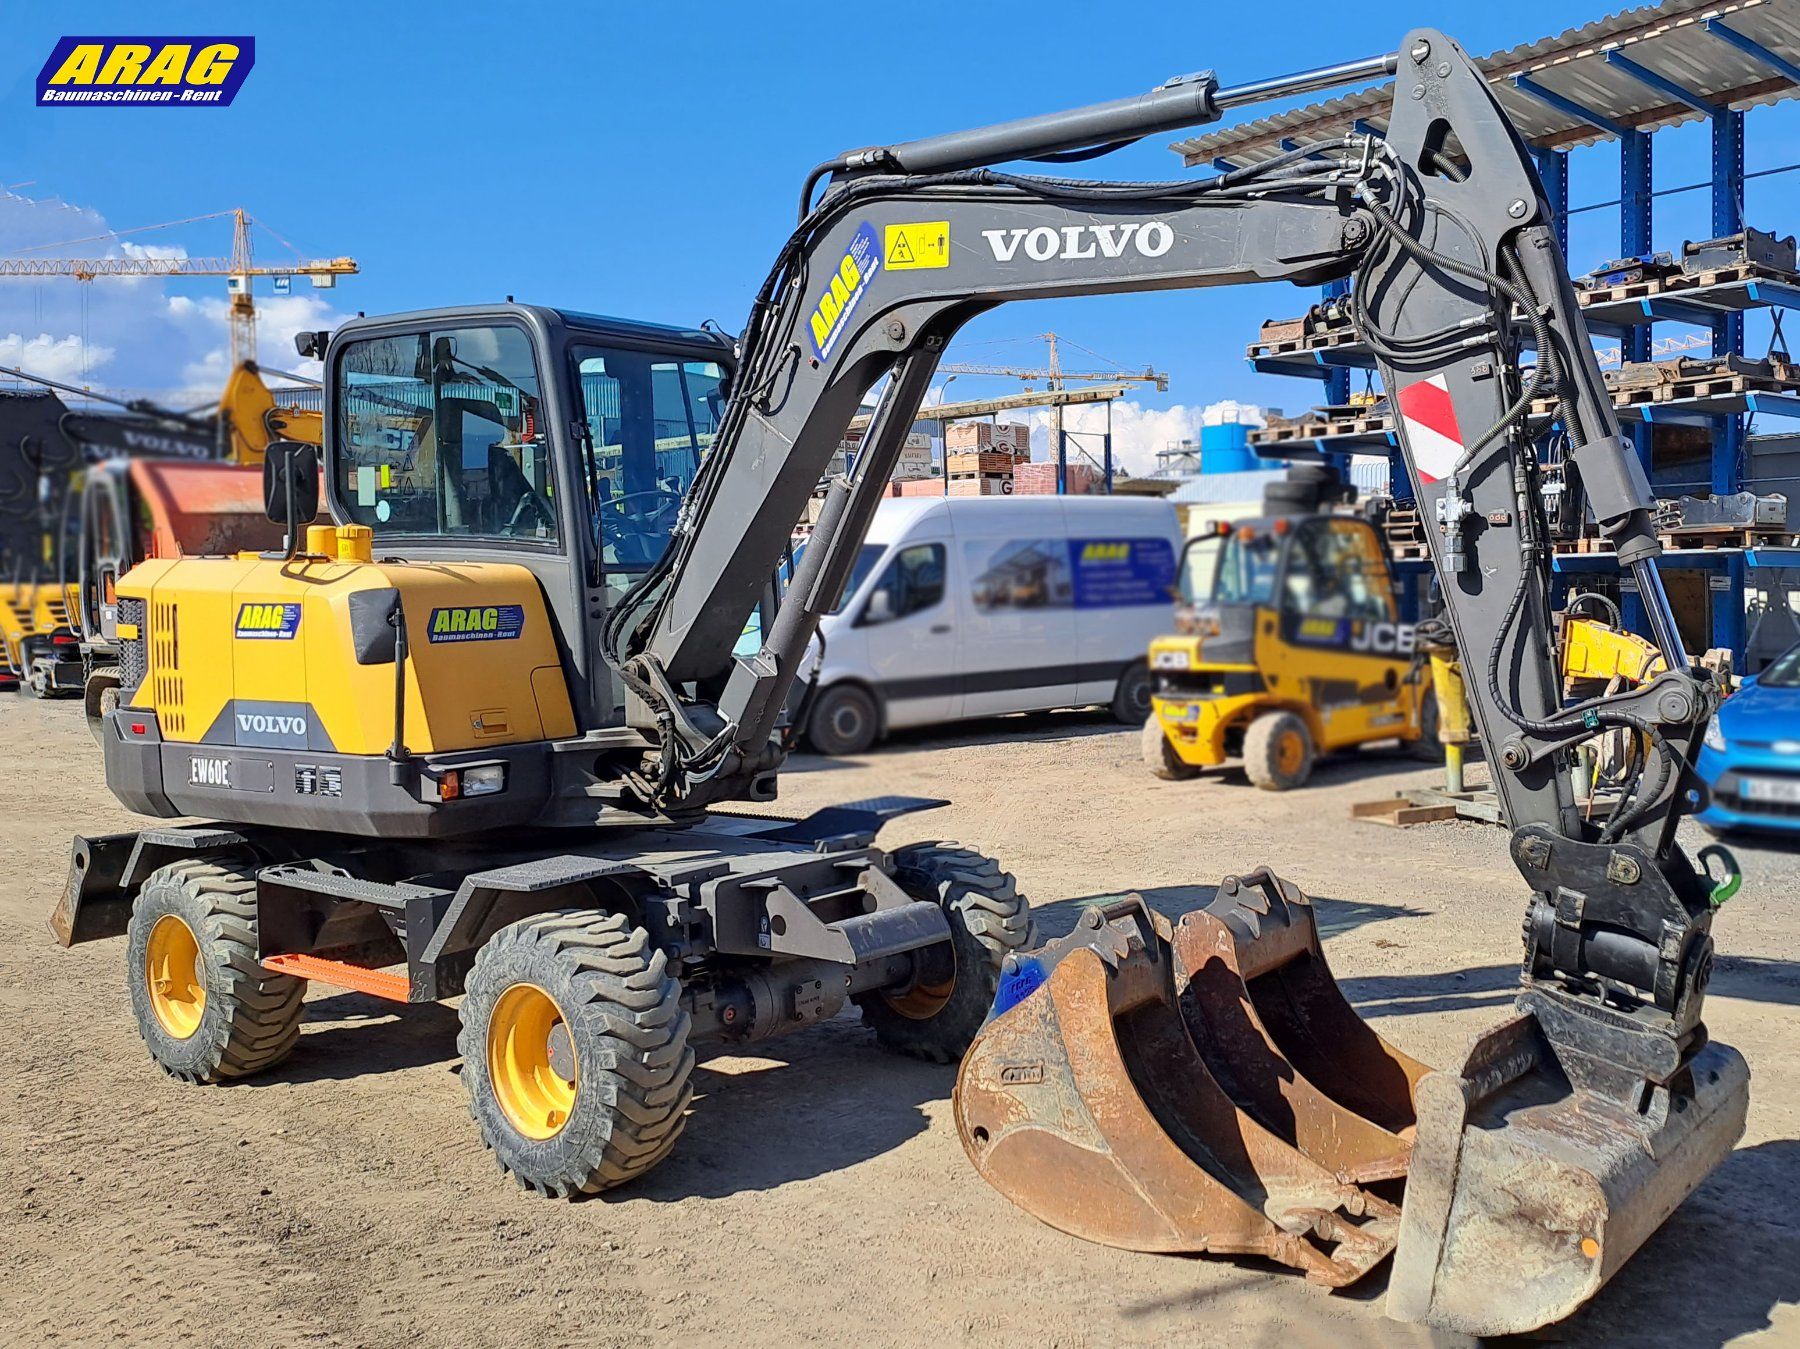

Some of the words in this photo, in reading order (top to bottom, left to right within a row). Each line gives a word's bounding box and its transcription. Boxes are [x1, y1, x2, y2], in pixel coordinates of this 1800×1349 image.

[981, 221, 1175, 262] VOLVO
[810, 254, 861, 350] ARAG
[123, 431, 209, 459] VOLVO
[1001, 480, 1013, 496] G
[238, 605, 284, 630] ARAG
[433, 607, 498, 633] ARAG
[1351, 621, 1416, 653] JCB
[236, 713, 307, 735] VOLVO
[191, 757, 229, 785] EW60E
